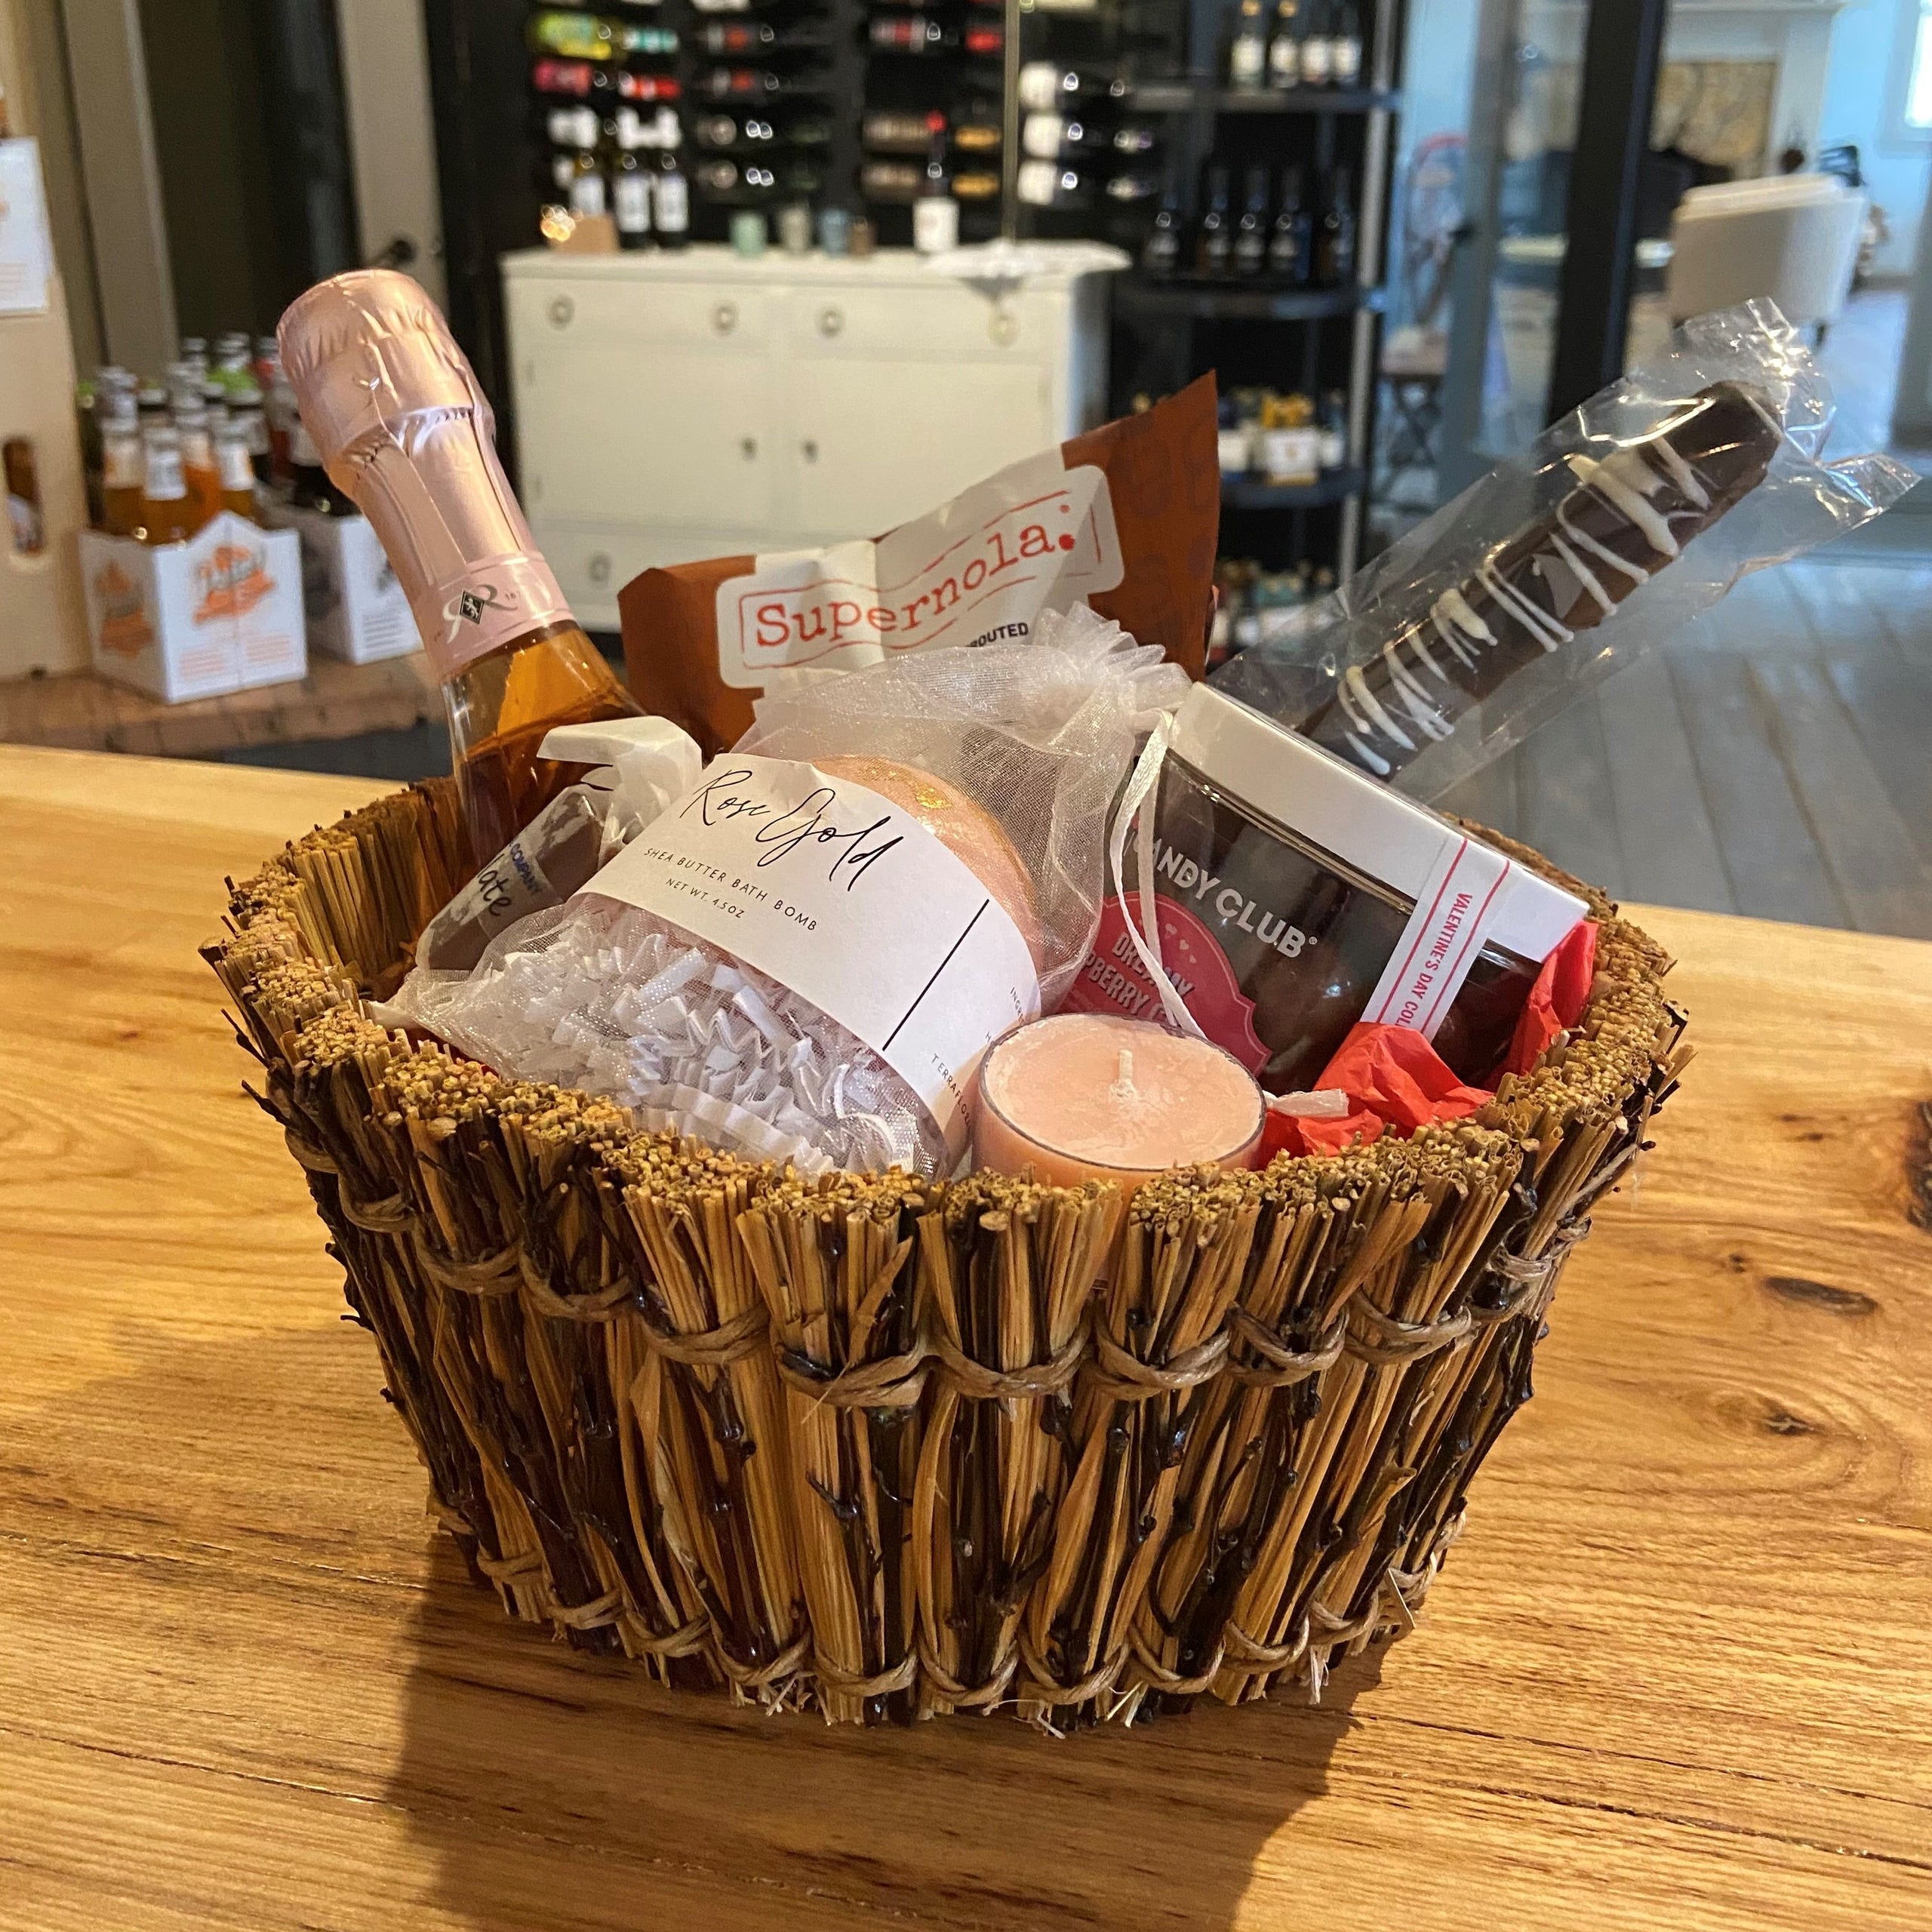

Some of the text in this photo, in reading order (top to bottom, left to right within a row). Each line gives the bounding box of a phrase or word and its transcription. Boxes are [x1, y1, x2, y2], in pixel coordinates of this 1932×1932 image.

[679, 769, 904, 892] Rose Gold
[1134, 835, 1221, 900] ANDY
[644, 848, 817, 931] SHEA BUTTER BATH BOMB
[666, 878, 686, 891] NET
[1395, 892, 1472, 1026] VALENTINE'S DAY COL
